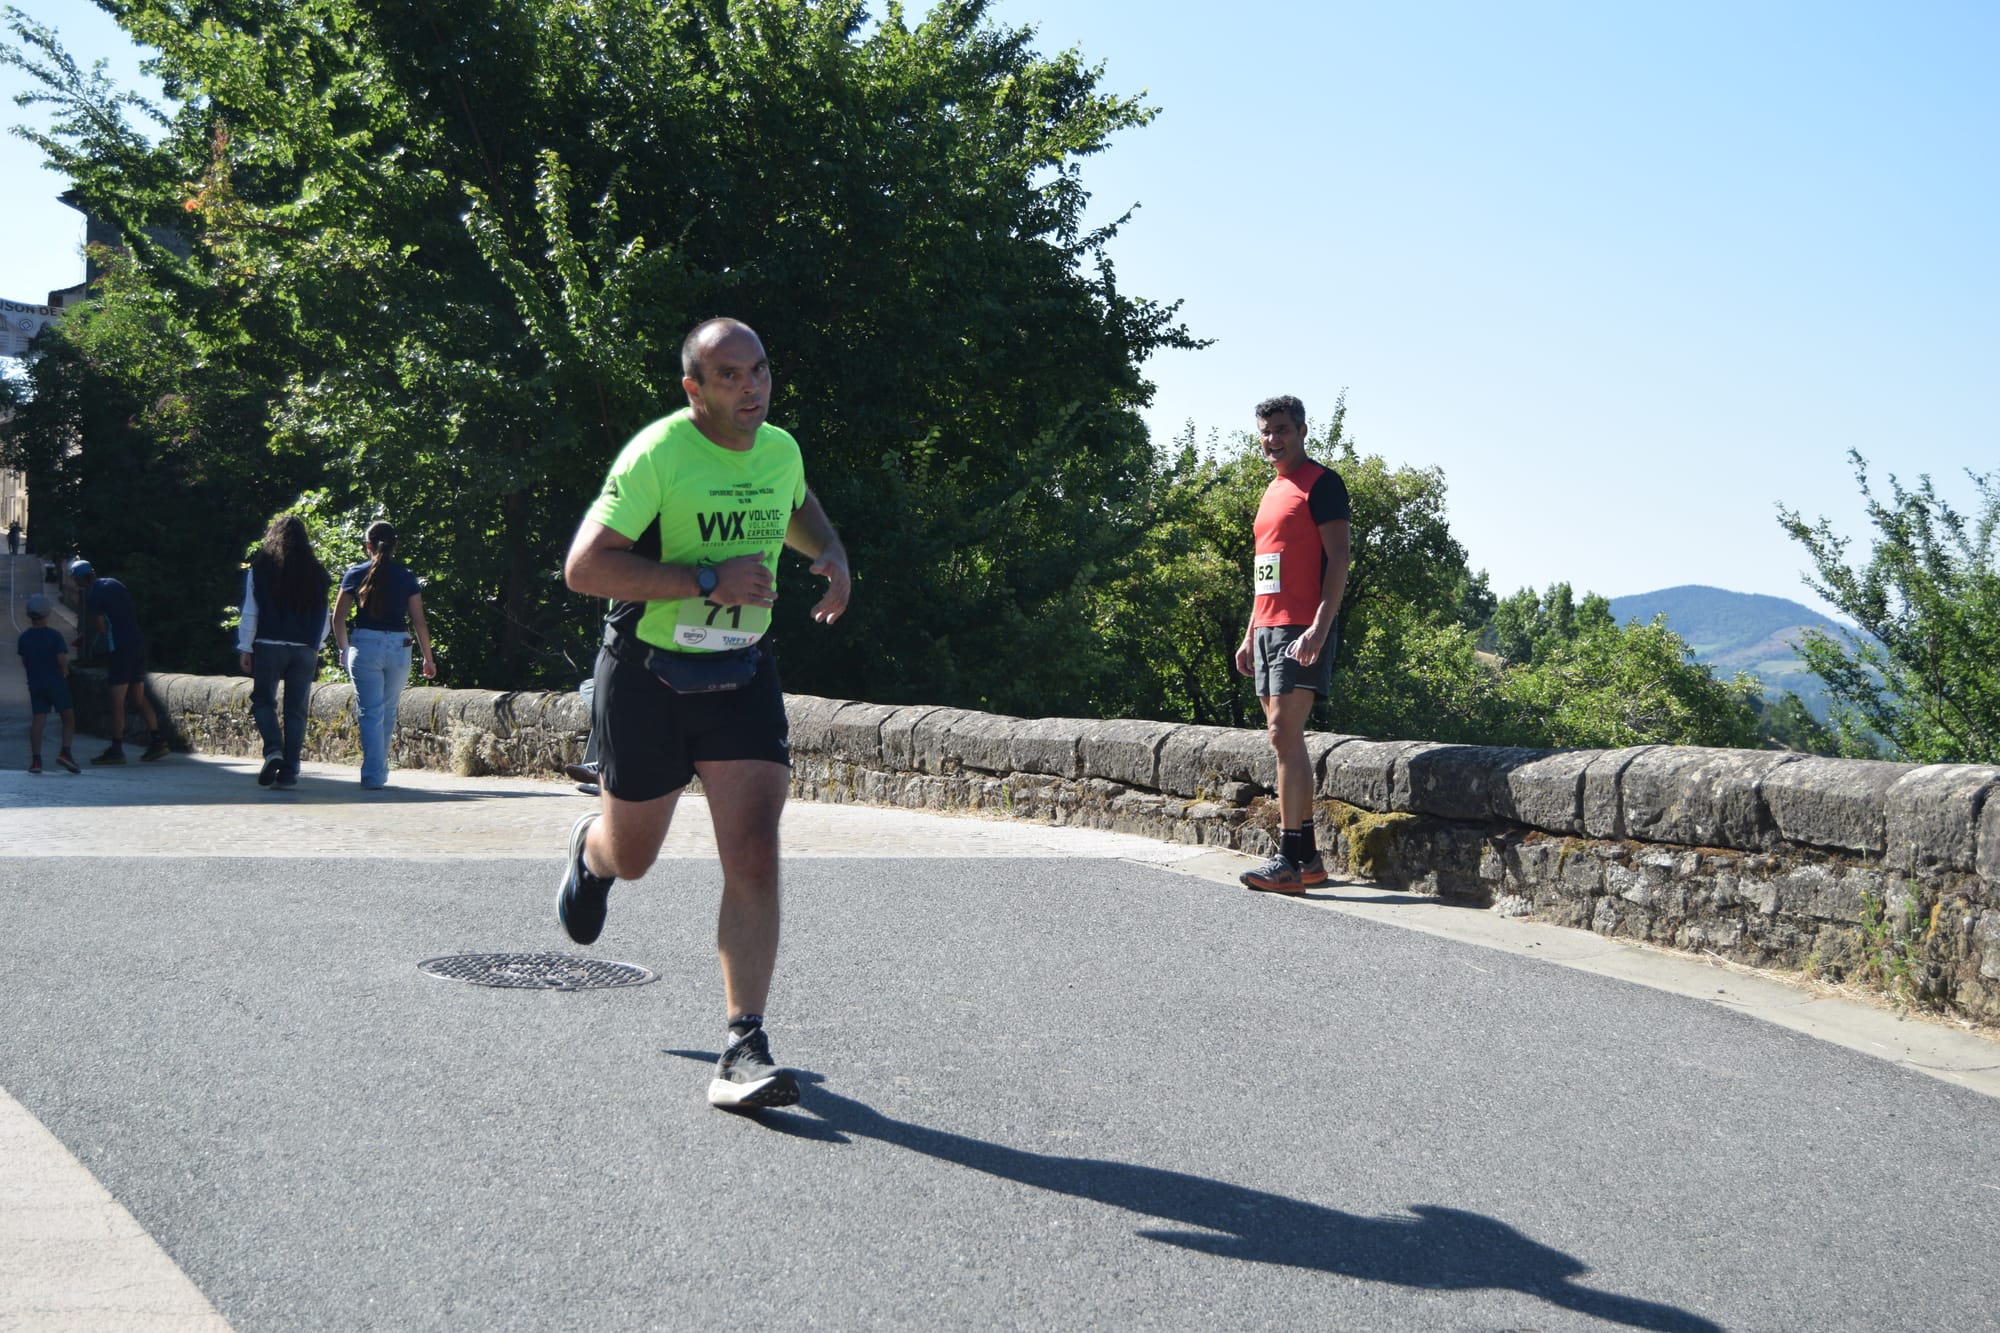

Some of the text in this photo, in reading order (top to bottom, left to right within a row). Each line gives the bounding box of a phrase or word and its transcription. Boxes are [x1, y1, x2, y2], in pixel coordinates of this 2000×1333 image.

[40, 307, 57, 316] DE
[697, 511, 747, 542] VVX
[704, 600, 741, 629] 71
